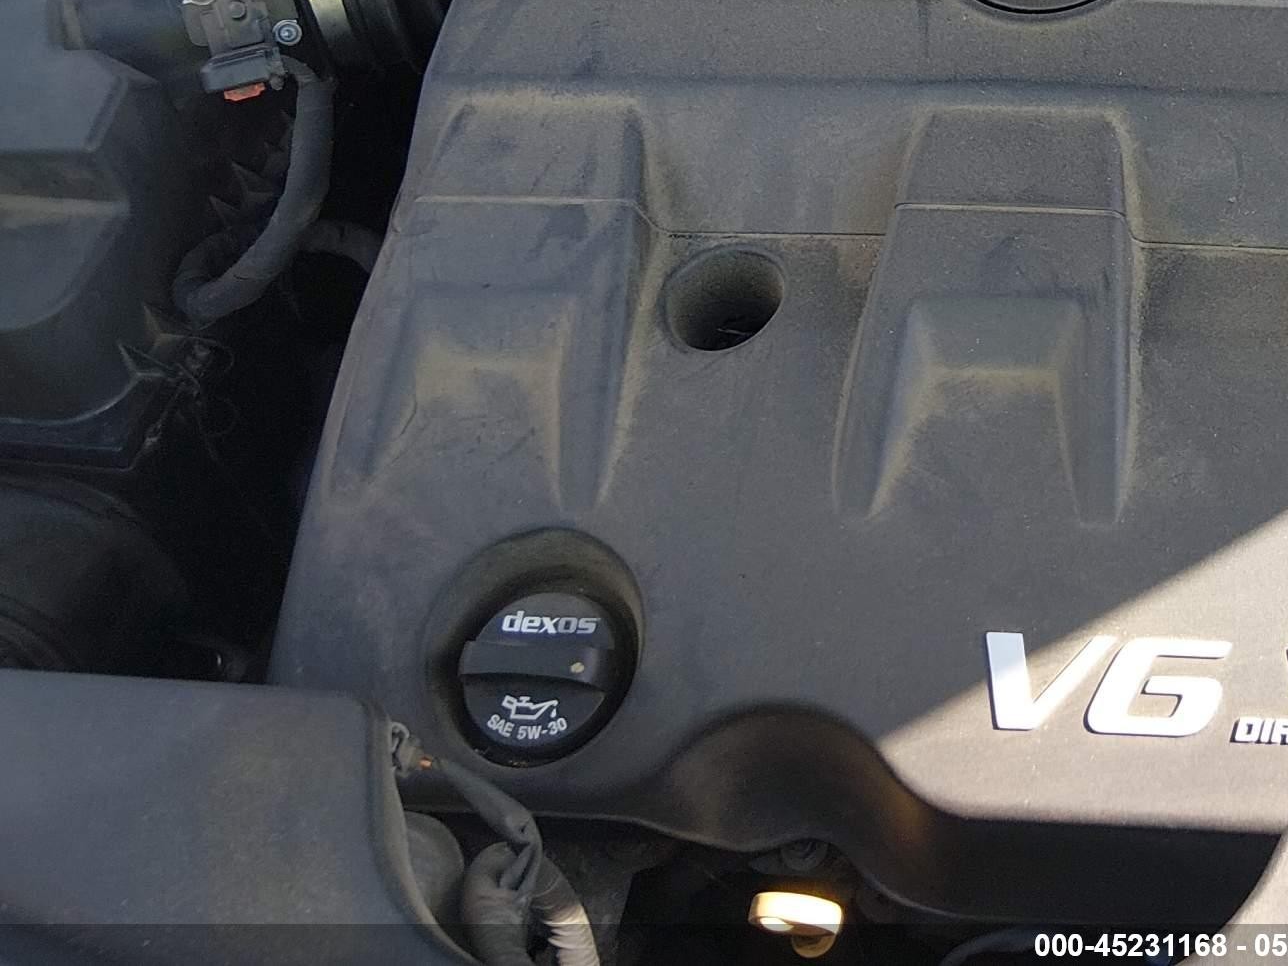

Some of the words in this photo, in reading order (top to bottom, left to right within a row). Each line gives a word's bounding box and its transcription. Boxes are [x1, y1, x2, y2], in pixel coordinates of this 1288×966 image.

[502, 610, 600, 634] dexos
[985, 632, 1232, 738] V6
[487, 714, 514, 737] SAE
[517, 718, 567, 739] 5W-30
